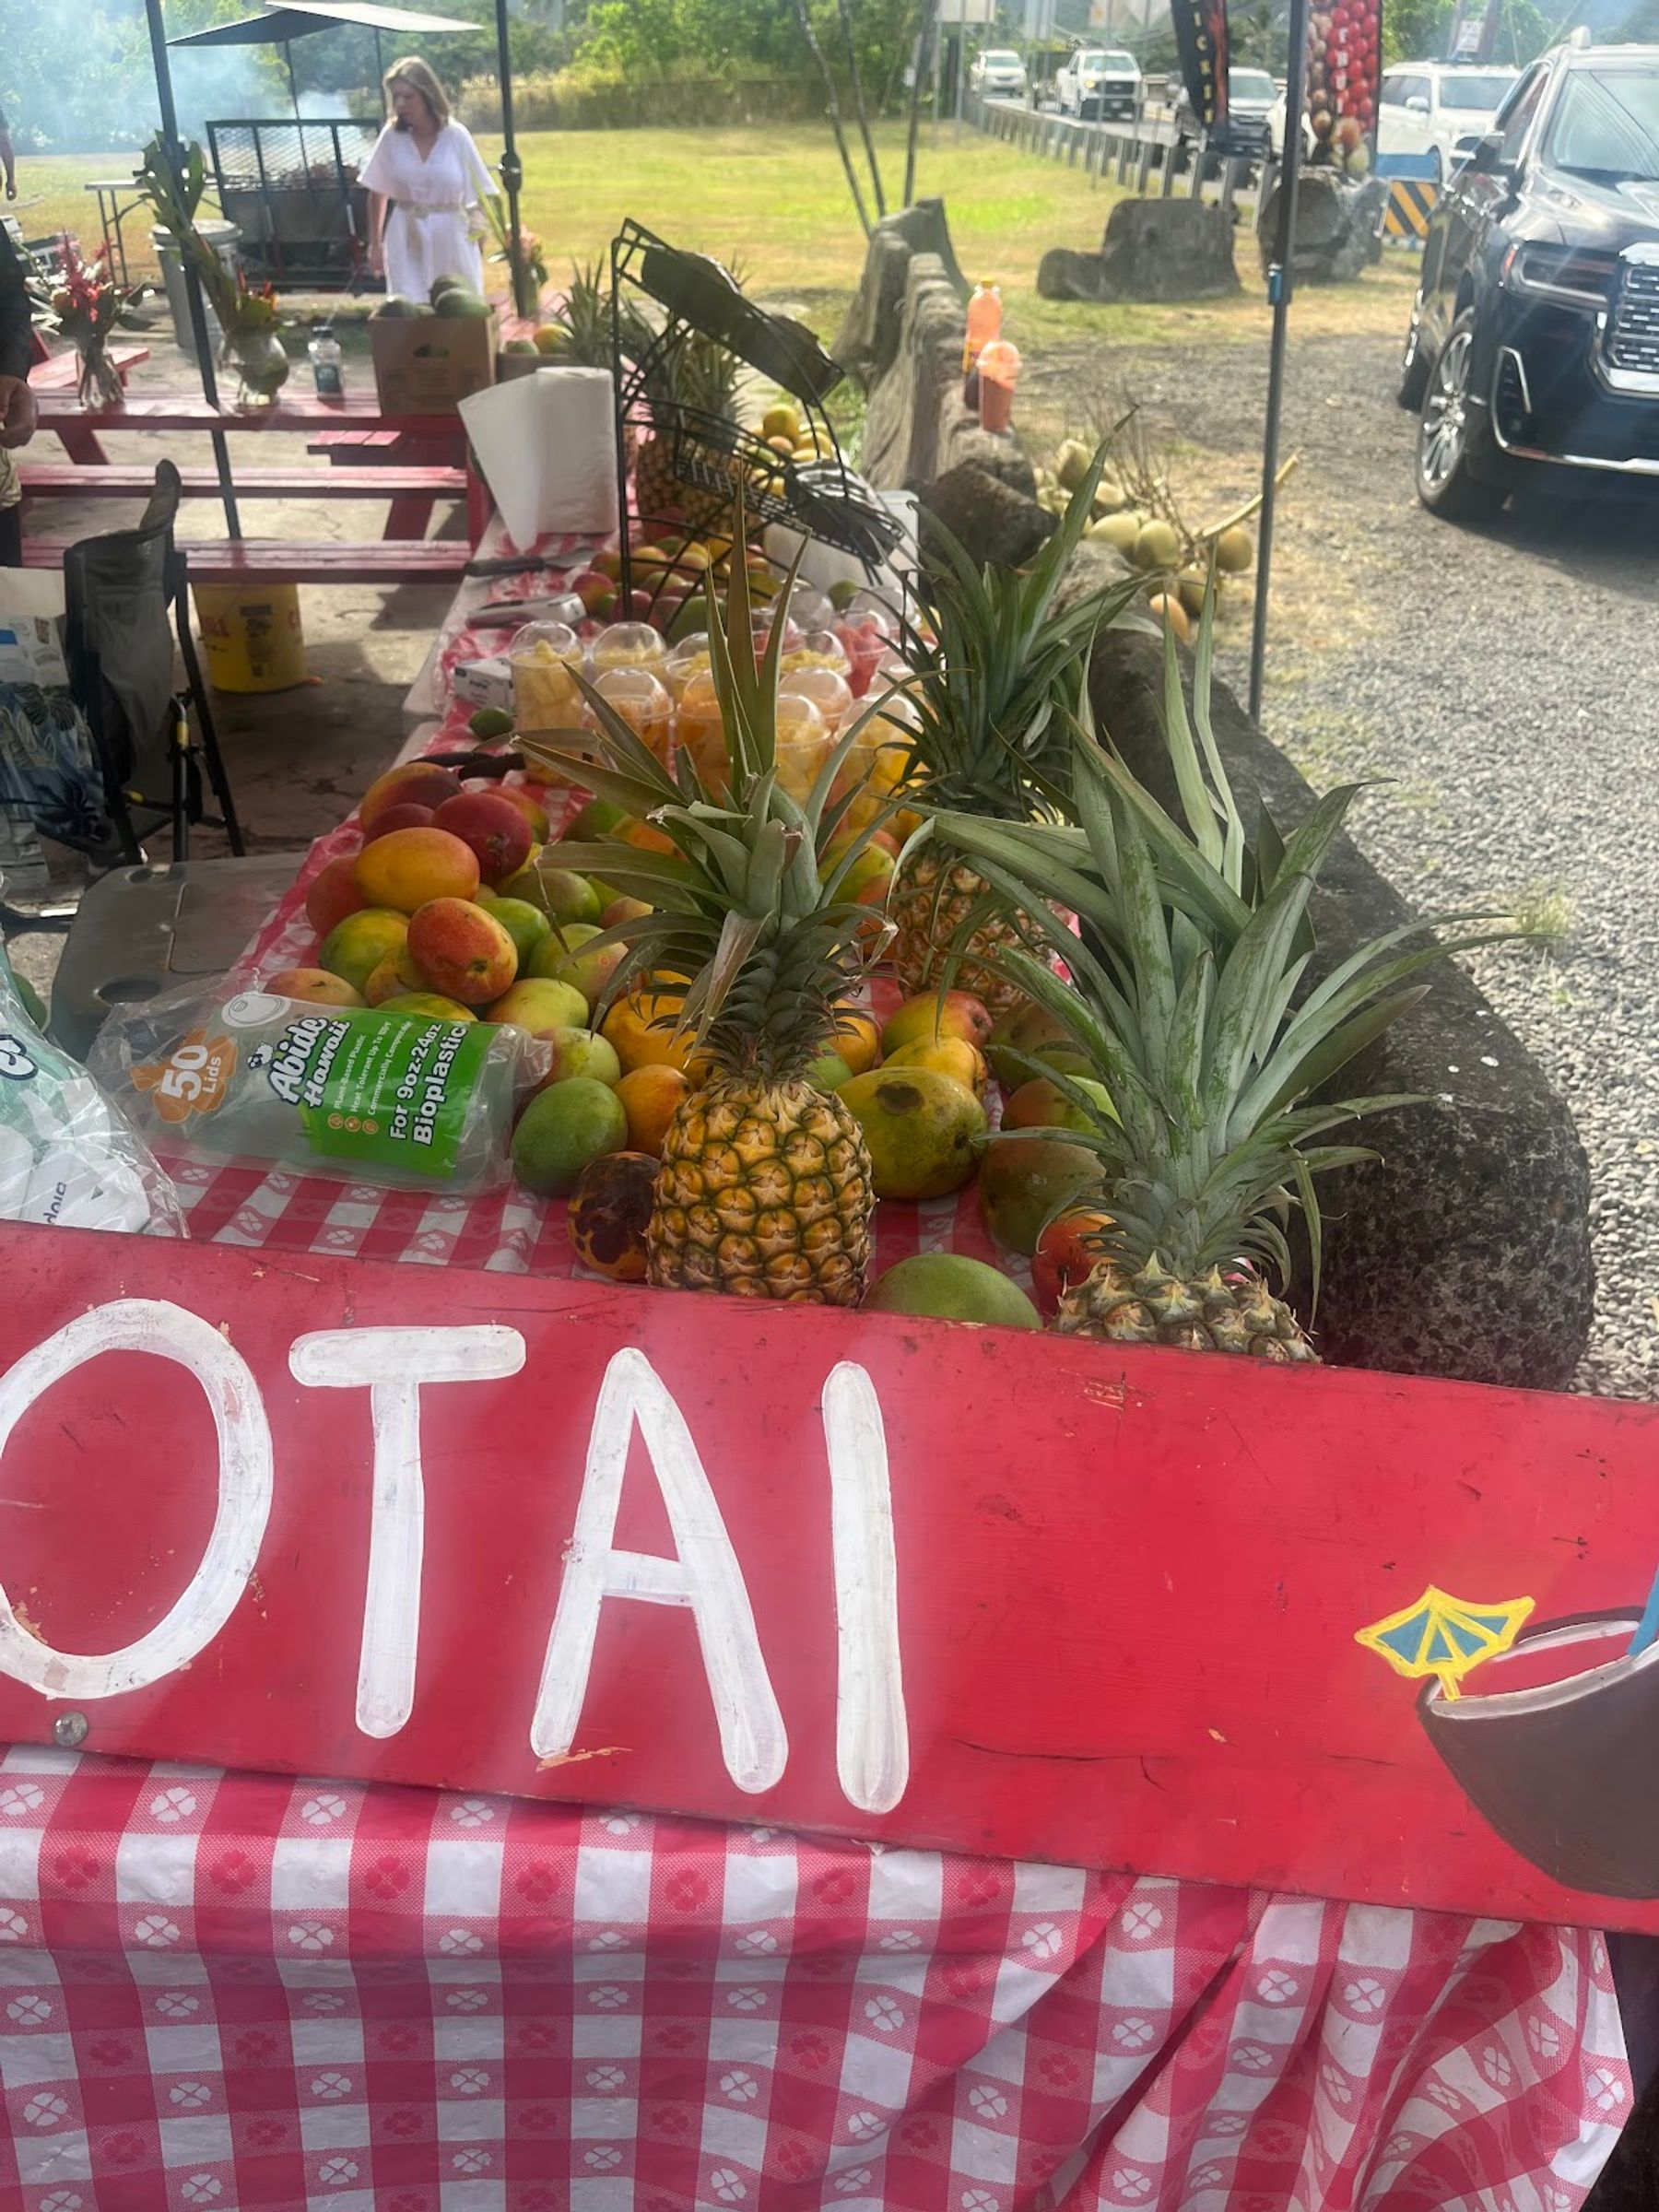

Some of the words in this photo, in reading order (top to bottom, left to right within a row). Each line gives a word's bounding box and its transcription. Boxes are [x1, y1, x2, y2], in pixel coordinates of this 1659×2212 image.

[1191, 0, 1215, 124] ICKEN
[269, 1018, 328, 1104] Abide
[302, 1020, 350, 1108] Hawaii
[368, 1044, 380, 1056] Up
[372, 1034, 383, 1043] To
[396, 1023, 442, 1100] 9oz-24oz
[161, 1044, 208, 1101] 50
[202, 1056, 221, 1094] Lids
[334, 1058, 356, 1110] Plant-Based
[350, 1034, 367, 1059] Plastic
[356, 1055, 375, 1089] Tolerant
[368, 1058, 394, 1115] Commercially
[412, 1026, 467, 1145] Bioplastic
[350, 1091, 362, 1112] Heat
[390, 1103, 408, 1139] For
[0, 1297, 911, 1815] OTAI
